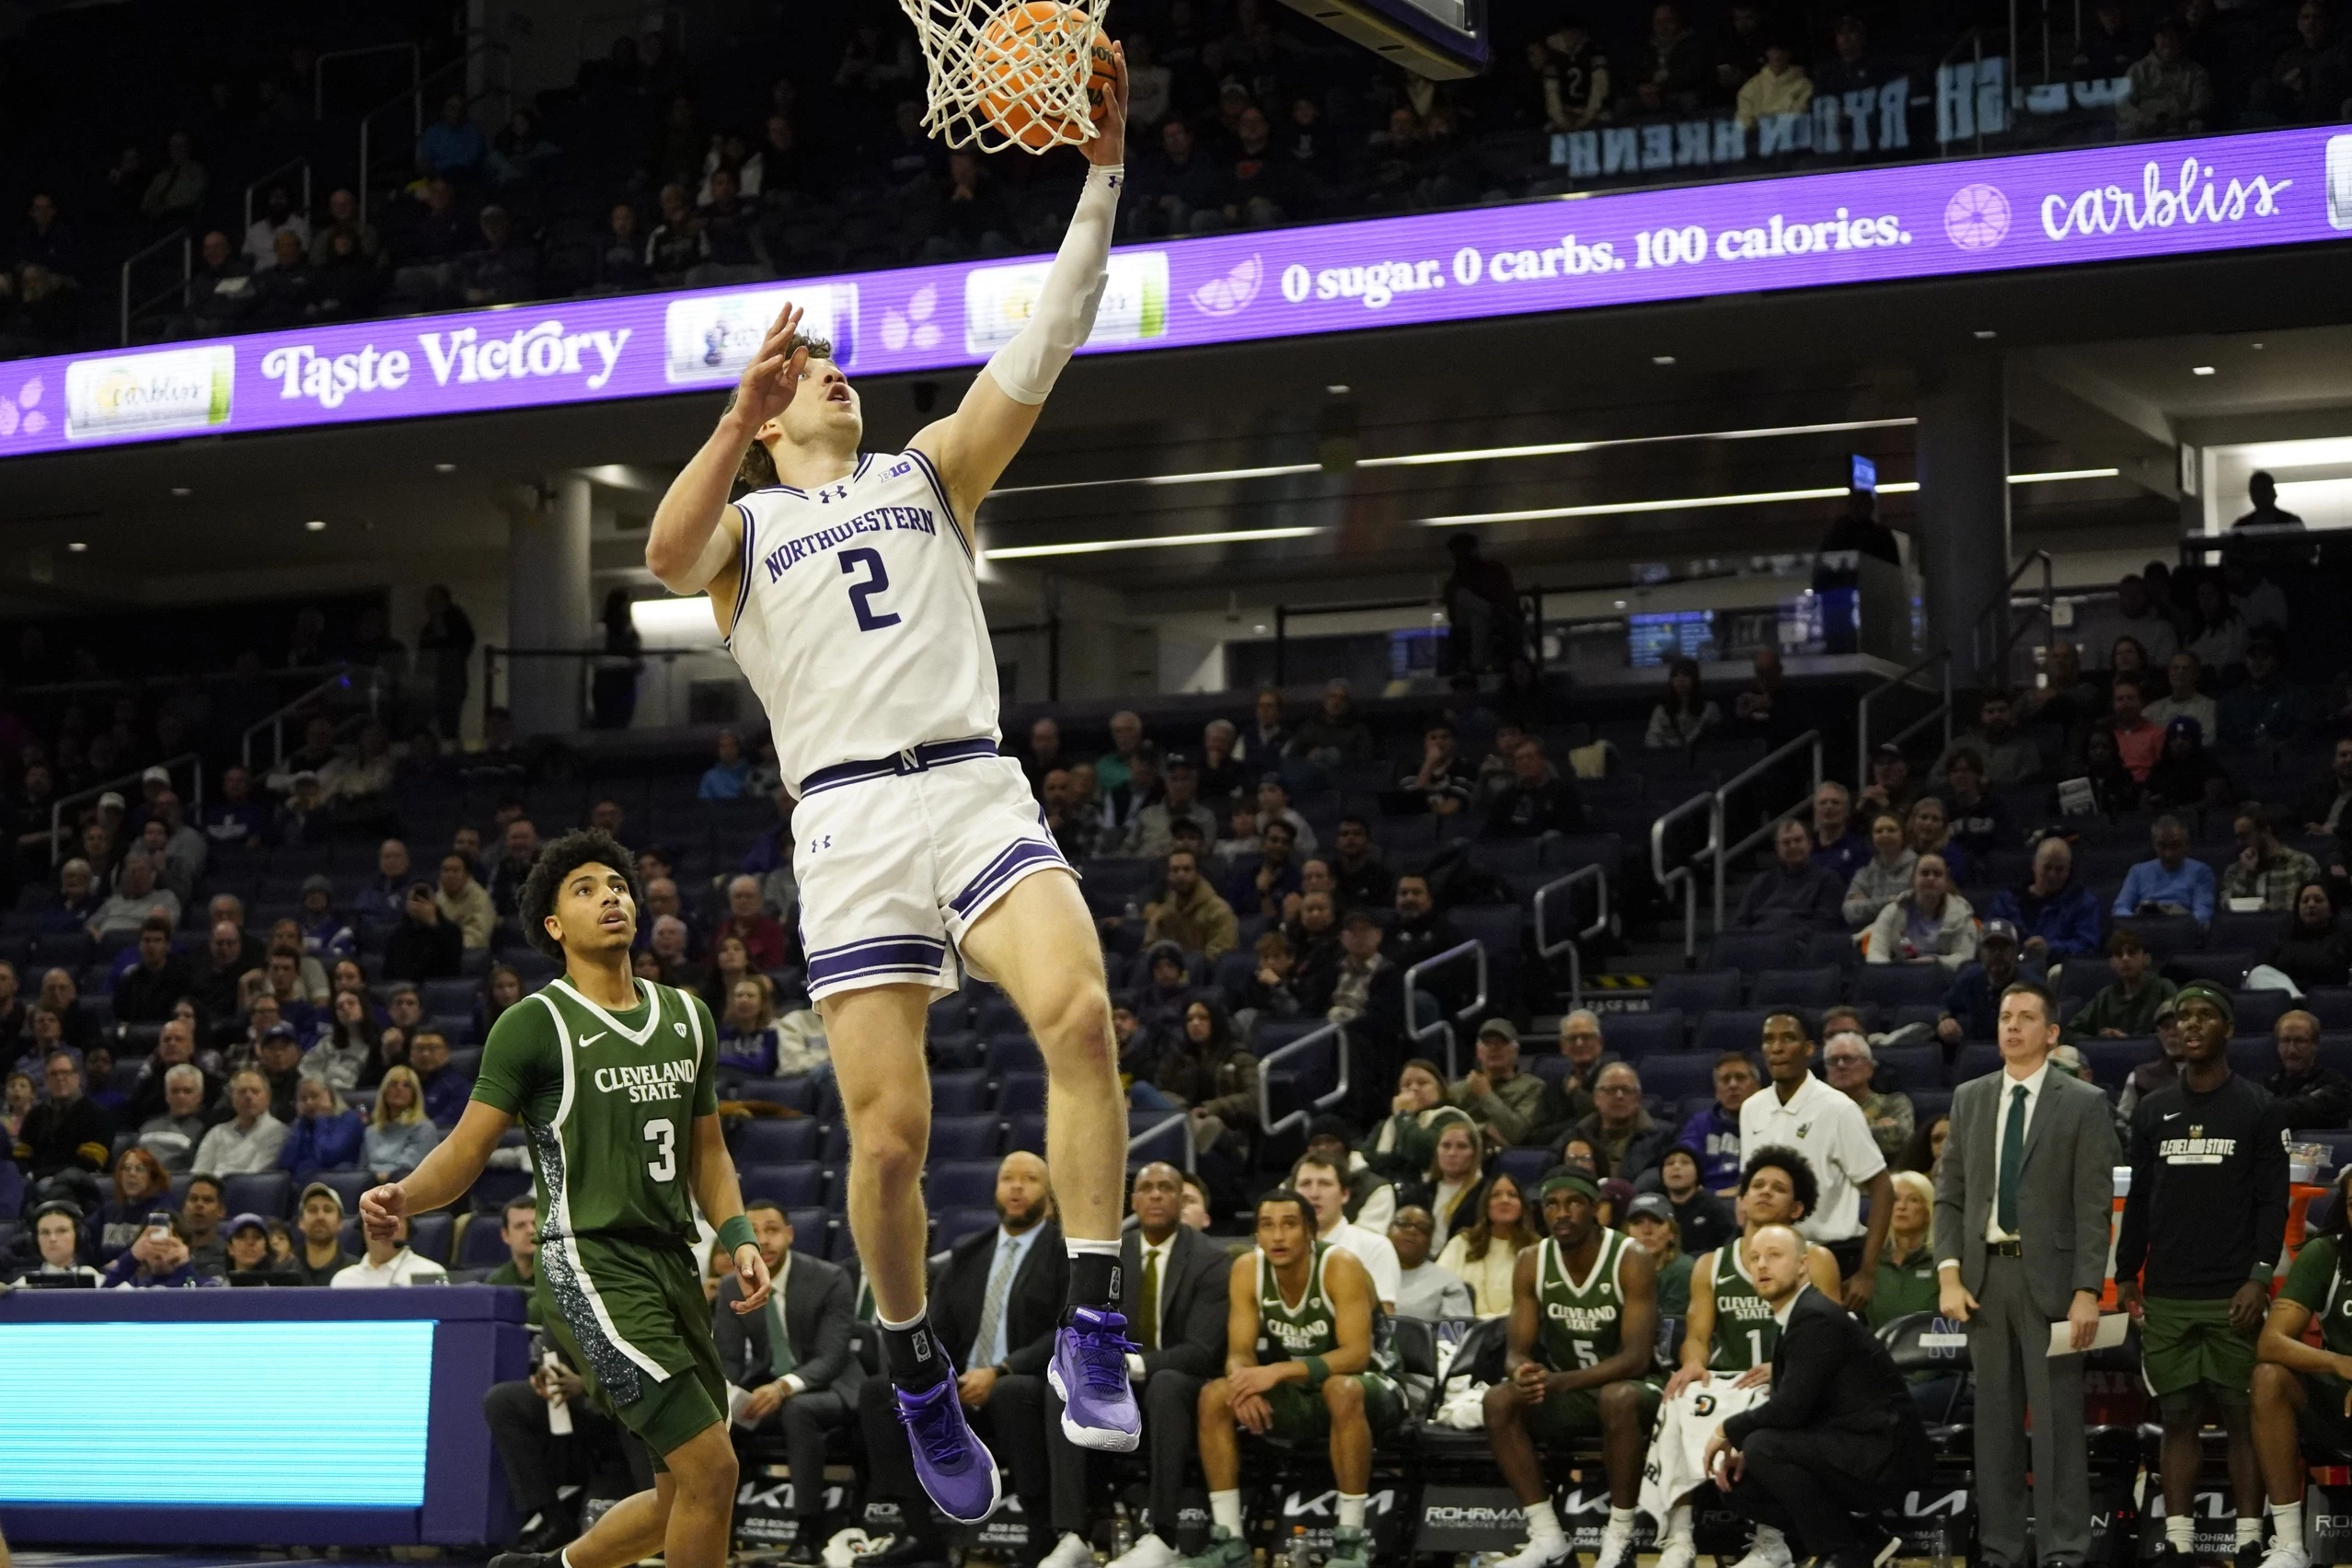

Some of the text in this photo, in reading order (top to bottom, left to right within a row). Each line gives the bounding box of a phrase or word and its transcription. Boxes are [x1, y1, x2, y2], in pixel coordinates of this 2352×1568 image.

[2041, 159, 2292, 241] carbliss
[1281, 208, 1911, 308] 0 sugar. 0 carbs. 100 calories.
[261, 320, 631, 409] Taste Victory
[764, 506, 937, 584] NORTHWESTERN
[836, 547, 903, 632] 2
[900, 746, 919, 771] N
[594, 1058, 696, 1093] CLEVELAND
[628, 1082, 682, 1103] STATE
[643, 1117, 677, 1183] 3
[2205, 1138, 2237, 1156] STATE
[1547, 1302, 1618, 1321] CLEVELAND
[1716, 1296, 1772, 1312] CLEVELA
[1735, 1308, 1772, 1320] STATE
[1565, 1319, 1601, 1332] STATE
[1573, 1339, 1599, 1369] 5
[1745, 1328, 1762, 1367] 1
